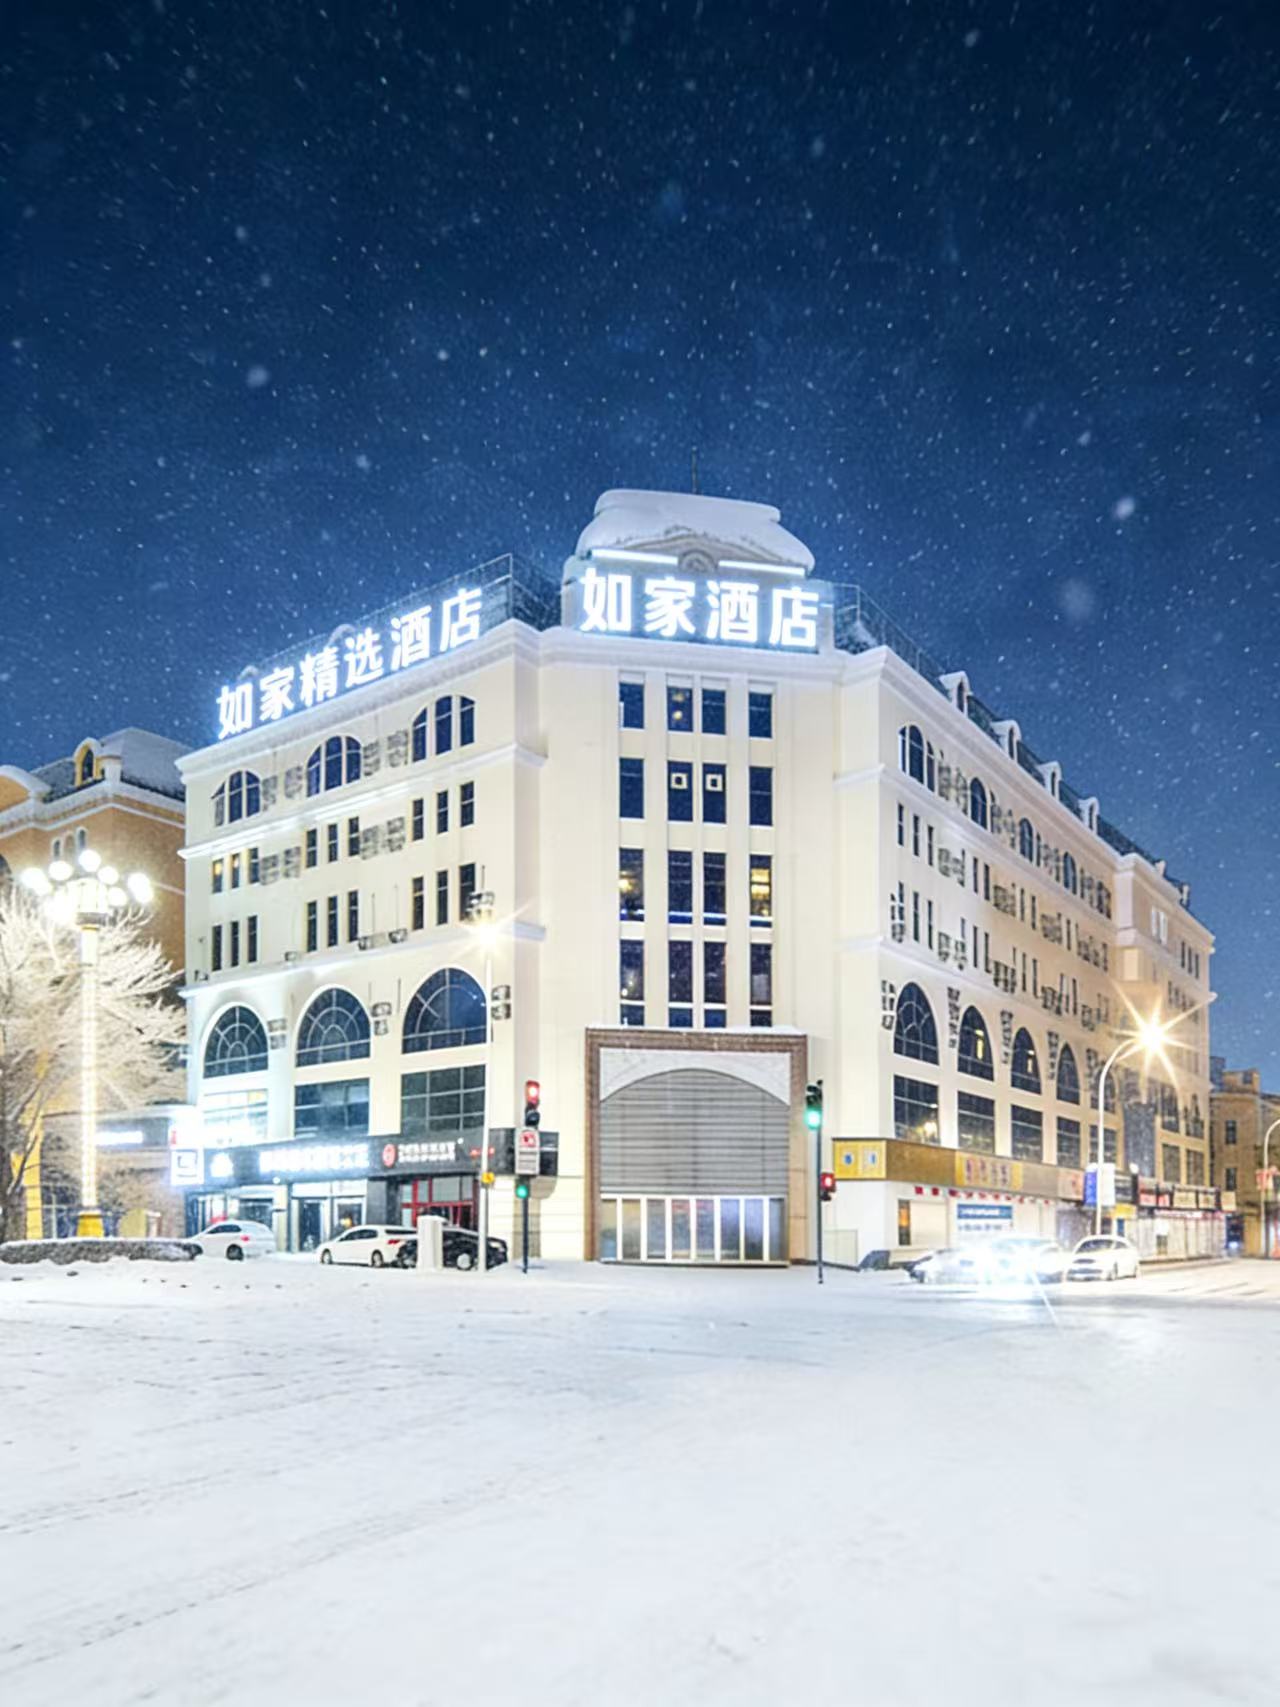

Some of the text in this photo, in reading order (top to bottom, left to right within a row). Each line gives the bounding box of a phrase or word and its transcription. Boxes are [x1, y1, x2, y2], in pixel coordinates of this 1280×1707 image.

[216, 587, 482, 740] 如家精选酒店
[579, 567, 820, 647] 如家酒店
